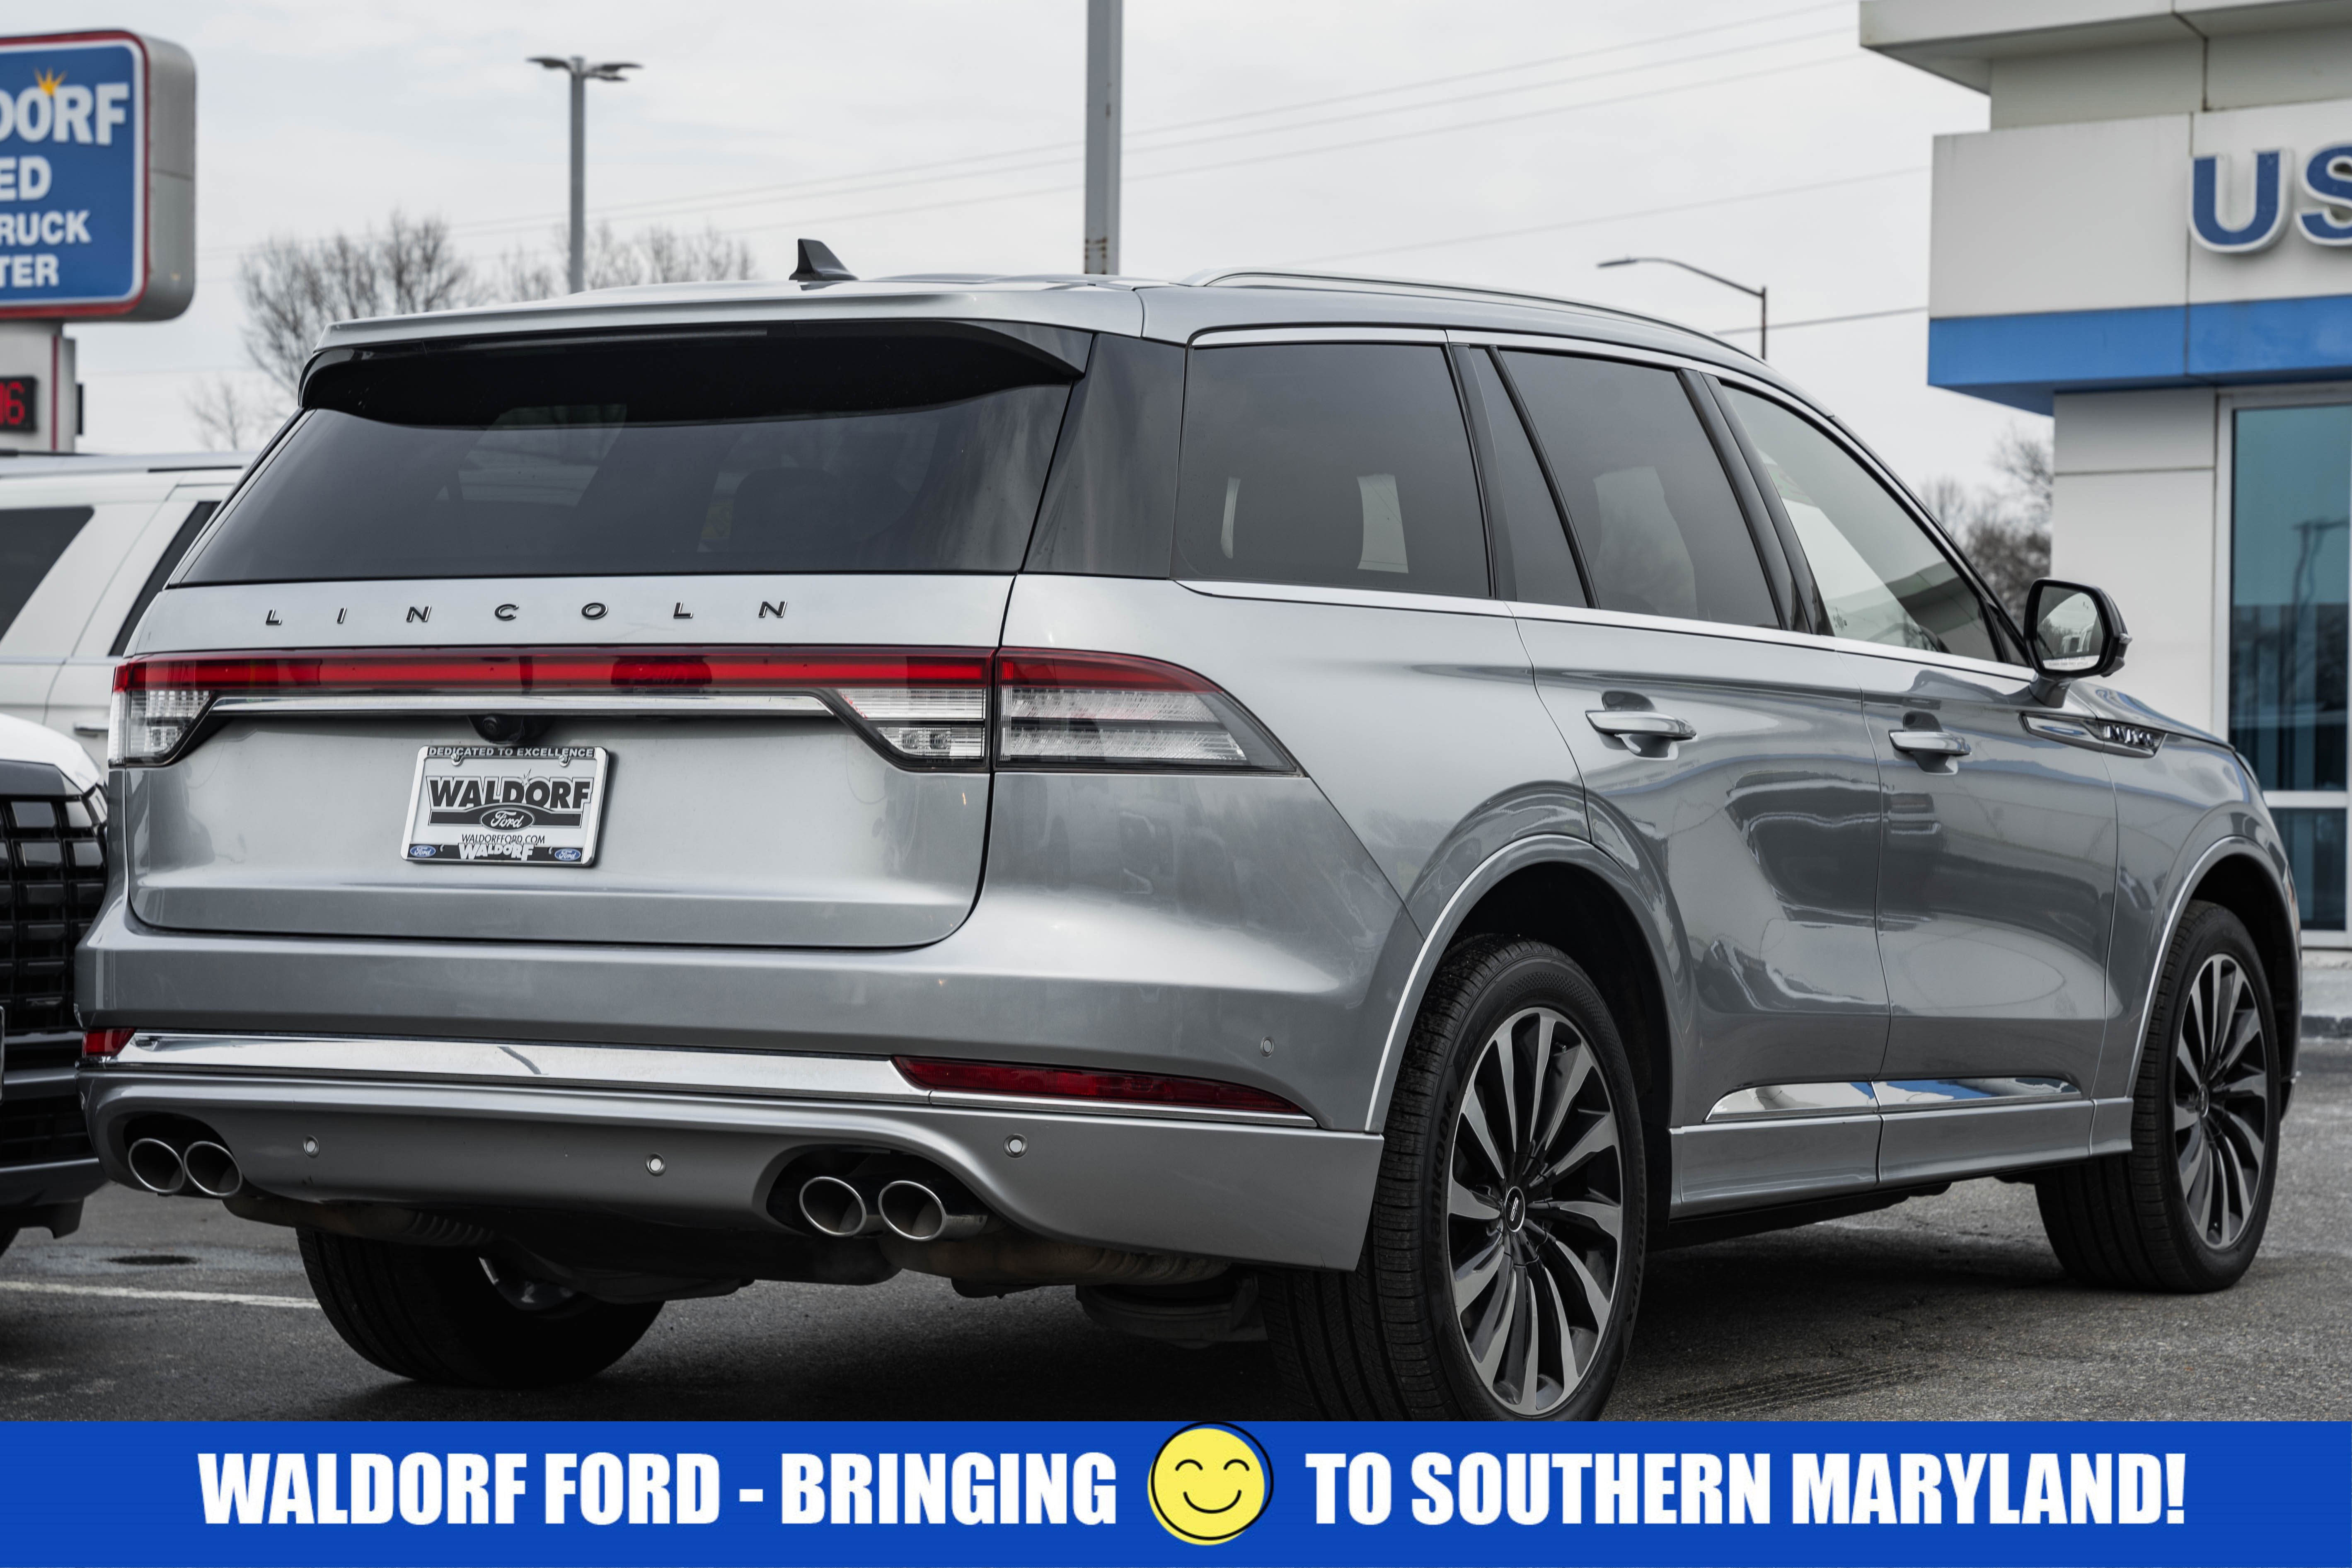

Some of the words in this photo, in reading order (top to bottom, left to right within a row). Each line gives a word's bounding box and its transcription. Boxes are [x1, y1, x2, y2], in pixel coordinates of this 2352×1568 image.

[2190, 143, 2352, 250] US
[0, 381, 25, 426] 6
[264, 601, 788, 626] LINCOLN
[428, 747, 494, 756] DEDICATED
[498, 748, 513, 756] TO
[517, 748, 594, 757] EXCELLENCE
[427, 777, 593, 811] WALDORF
[490, 810, 524, 828] Ford
[462, 834, 545, 844] WALDORFFORDCOM
[414, 846, 432, 857] Ford
[458, 842, 535, 861] WALDORF
[559, 849, 576, 859] Ford
